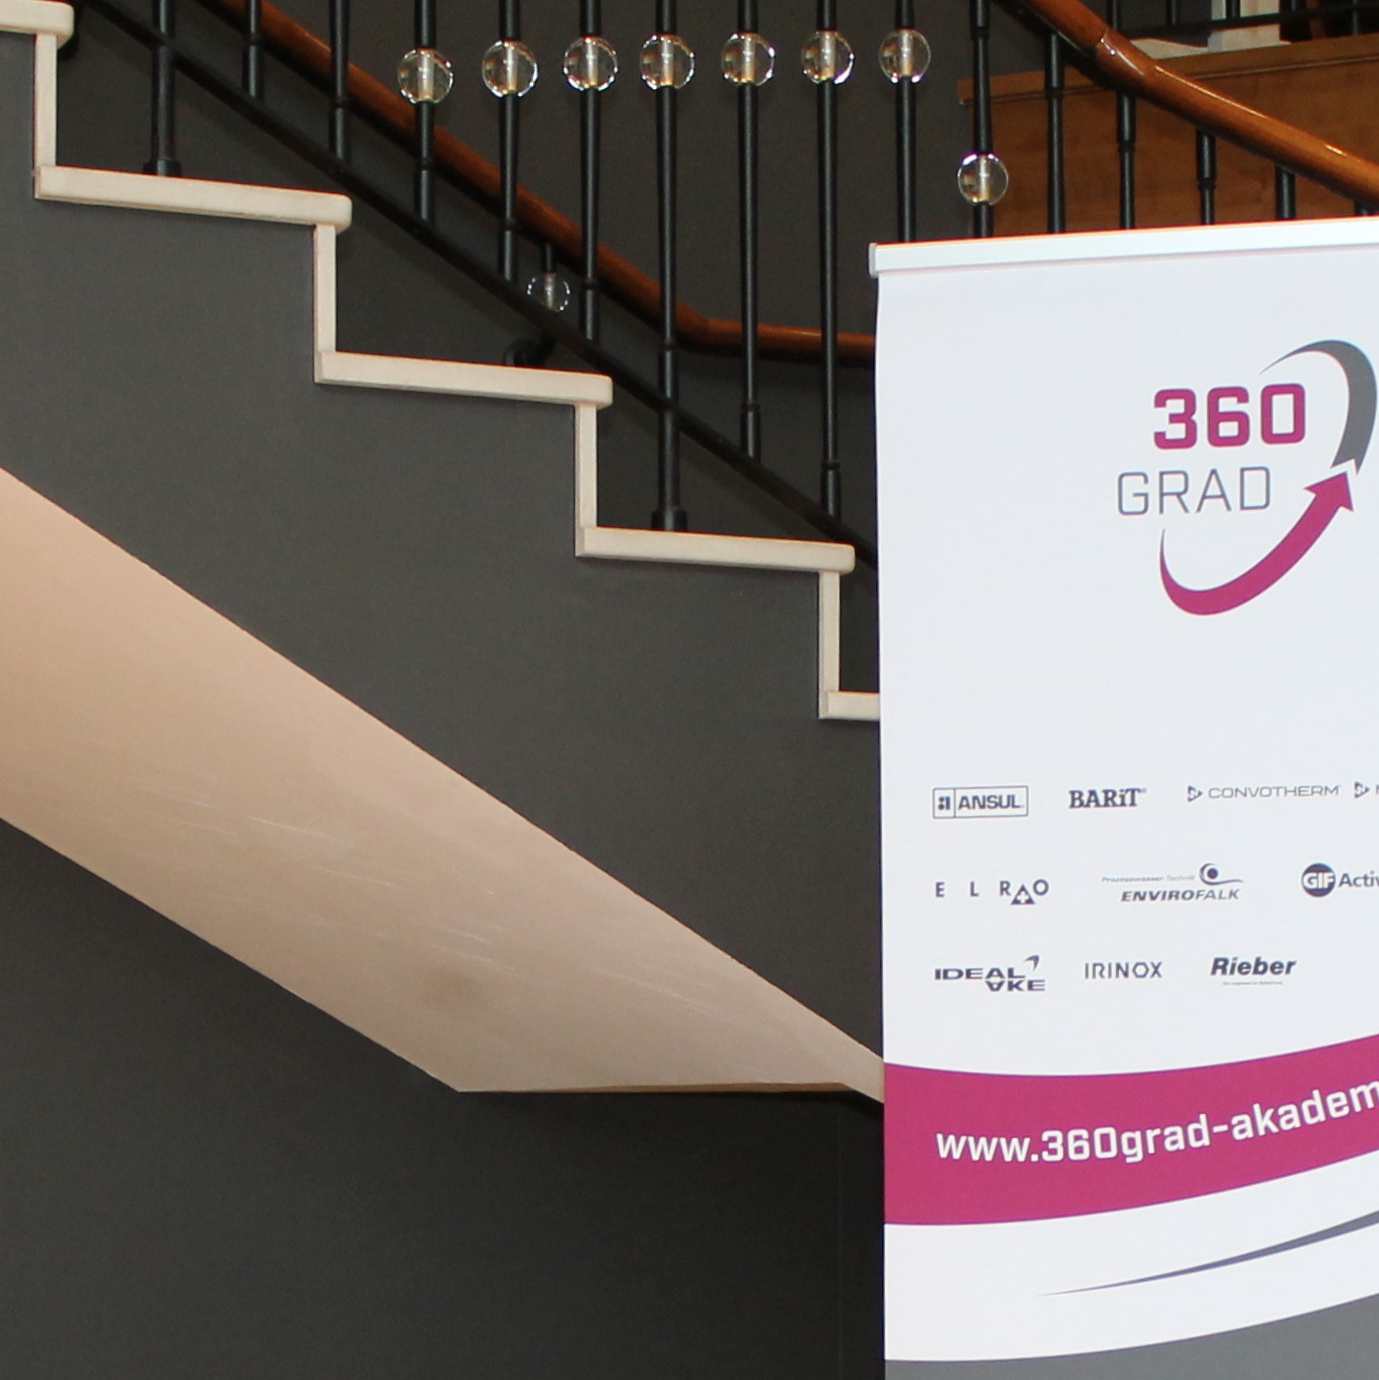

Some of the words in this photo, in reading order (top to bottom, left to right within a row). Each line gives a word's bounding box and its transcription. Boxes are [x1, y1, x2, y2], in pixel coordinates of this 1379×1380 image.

[1153, 382, 1306, 451] 360
[1117, 465, 1271, 516] GRAD
[1207, 784, 1340, 799] CONVOTHERM
[957, 793, 1022, 811] ANSUL
[1303, 872, 1333, 890] GIF
[1120, 889, 1240, 902] ENVIROFALK
[934, 967, 1026, 981] IDEAL
[1084, 961, 1163, 980] IRINOX
[1210, 956, 1297, 976] Rieber
